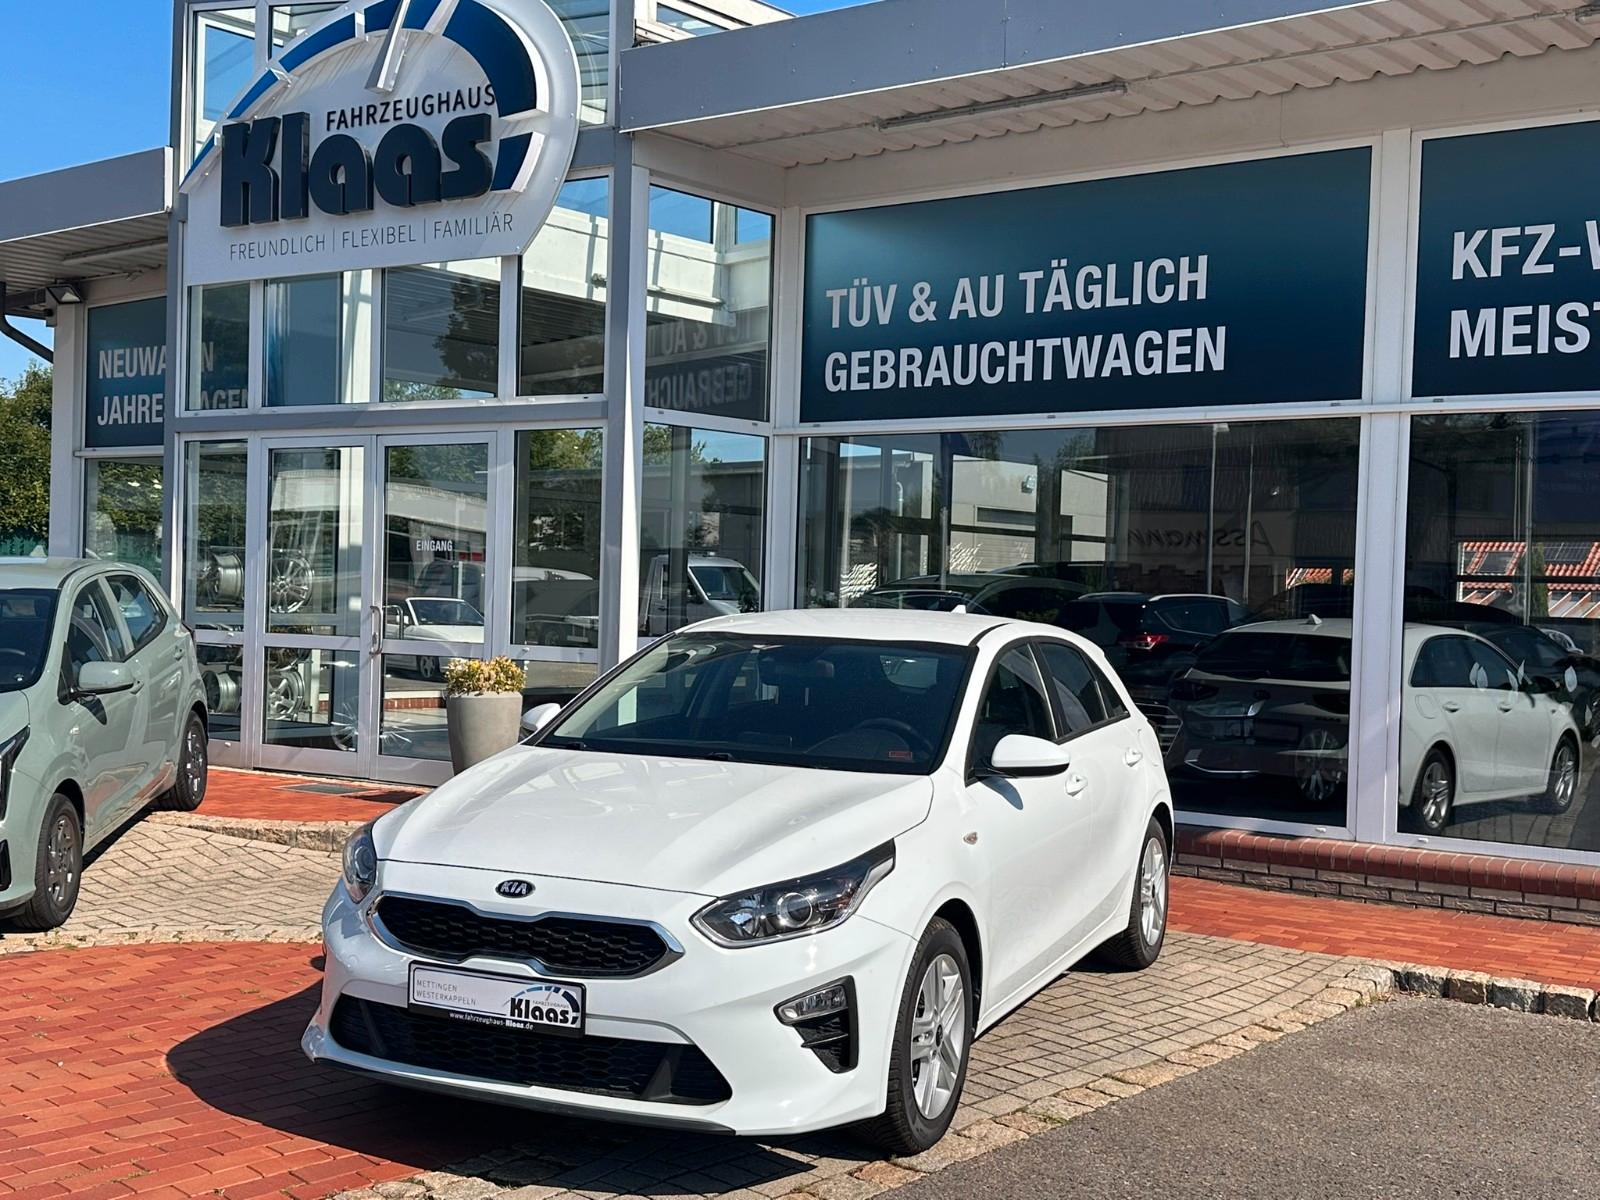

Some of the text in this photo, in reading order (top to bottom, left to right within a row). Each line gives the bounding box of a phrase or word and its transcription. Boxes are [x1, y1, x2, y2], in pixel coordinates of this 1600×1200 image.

[326, 84, 495, 131] FAHRZEUGHAUS
[219, 111, 494, 227] Klaas
[230, 211, 513, 261] FREUNDLICH FLEXIBEL FAMILIÄR
[826, 254, 1208, 328] TÜV & AU TÄGLICH
[1449, 301, 1600, 358] MEIS
[825, 326, 1226, 392] GEBRAUCHTWAGEN
[416, 540, 453, 552] EINGANG
[500, 881, 527, 894] KIA
[416, 979, 457, 992] METTINGEN
[416, 990, 476, 1006] WESTERKAPPELN
[510, 997, 569, 1024] Klaas
